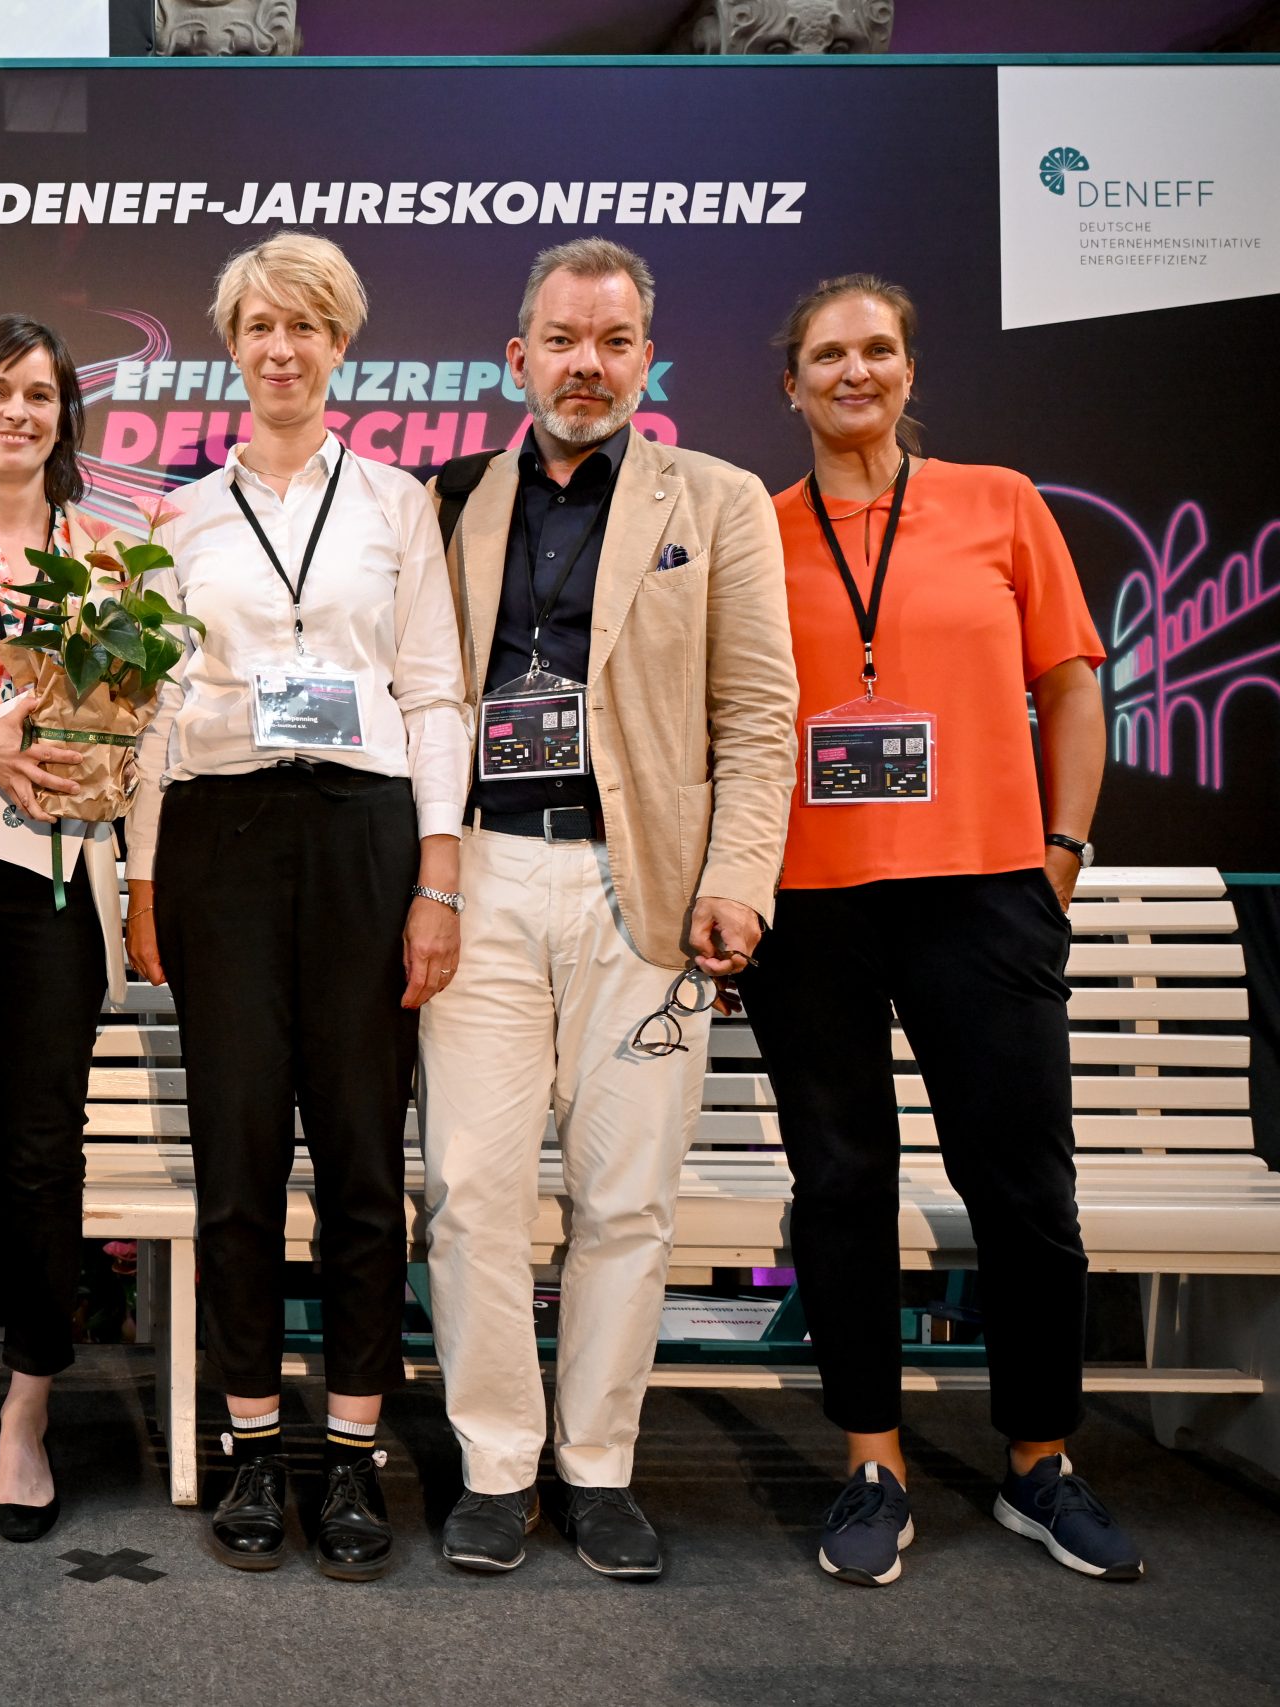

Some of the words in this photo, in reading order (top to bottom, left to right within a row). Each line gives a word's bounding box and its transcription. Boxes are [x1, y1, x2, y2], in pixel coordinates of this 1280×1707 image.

[1078, 180, 1215, 208] DENEFF
[1079, 221, 1152, 233] DEUTSCHE
[1079, 238, 1262, 249] UNTERNEHMENSINITIATIVE
[1080, 254, 1208, 266] ENERGIEEFFIZIENZ
[112, 361, 674, 402] EFFIZNZREPUK
